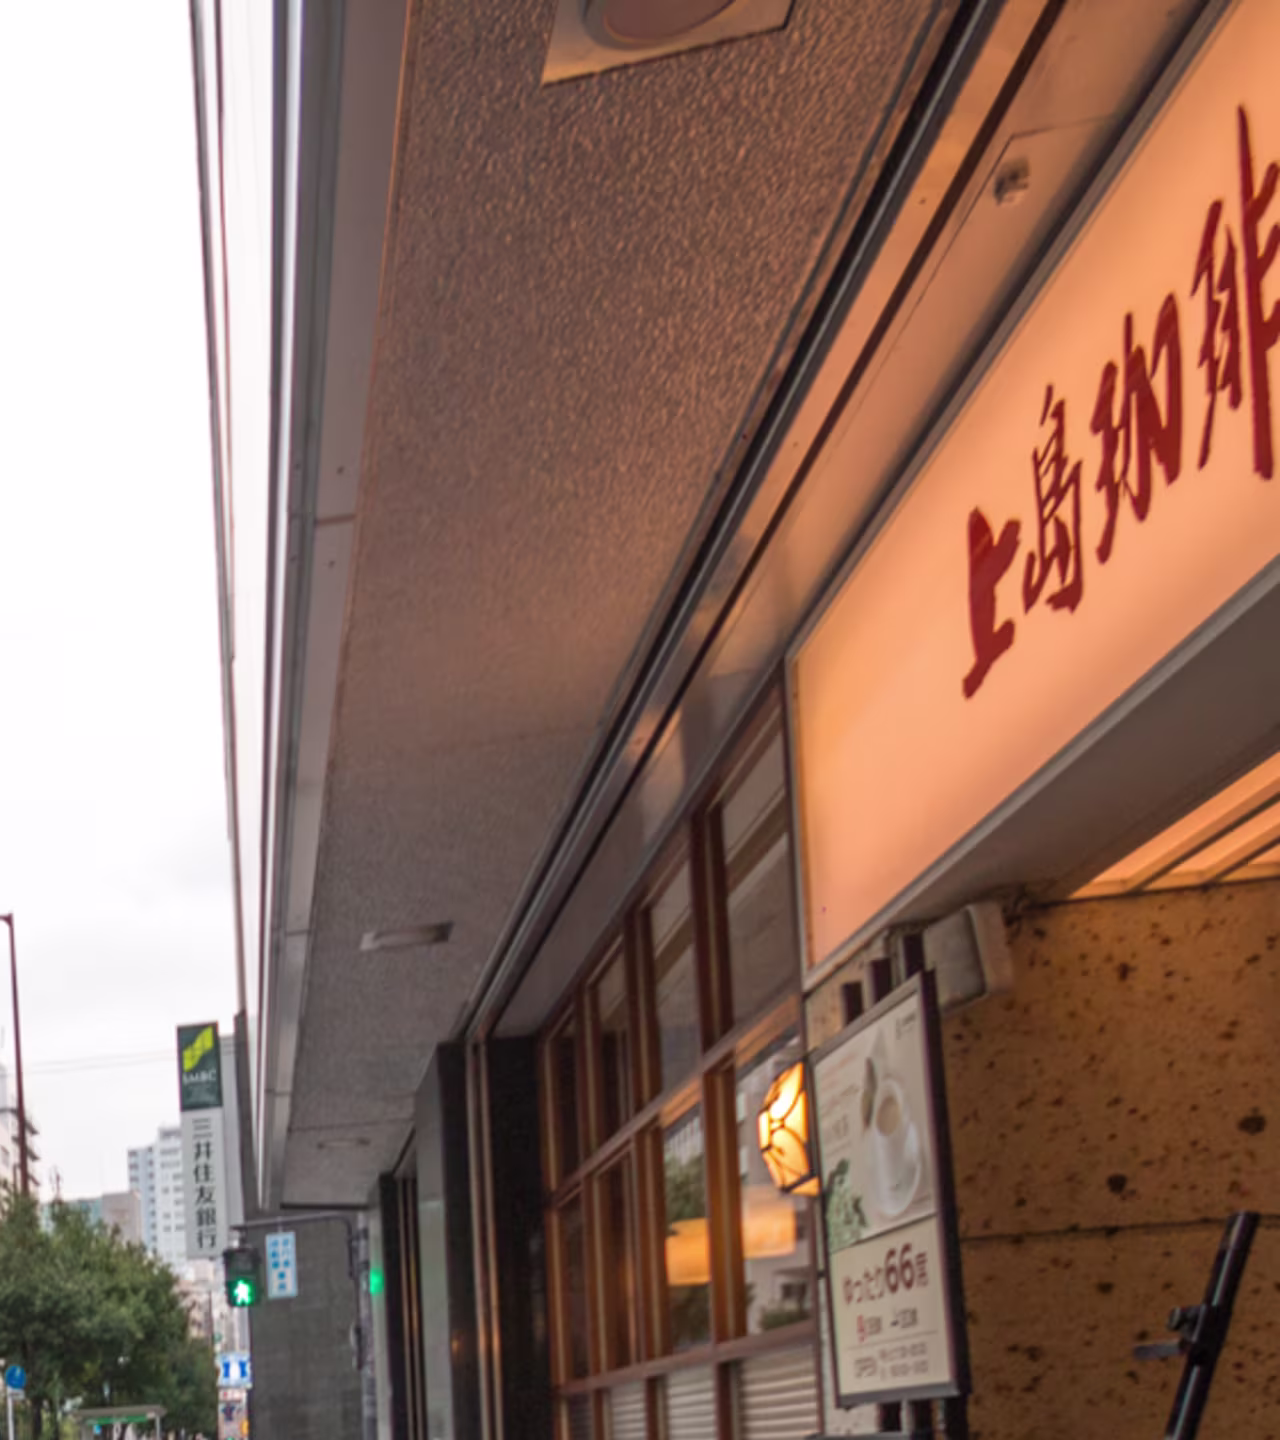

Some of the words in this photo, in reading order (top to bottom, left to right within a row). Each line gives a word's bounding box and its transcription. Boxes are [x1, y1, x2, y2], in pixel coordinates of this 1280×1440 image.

[192, 1116, 218, 1250] 三井住友銀行
